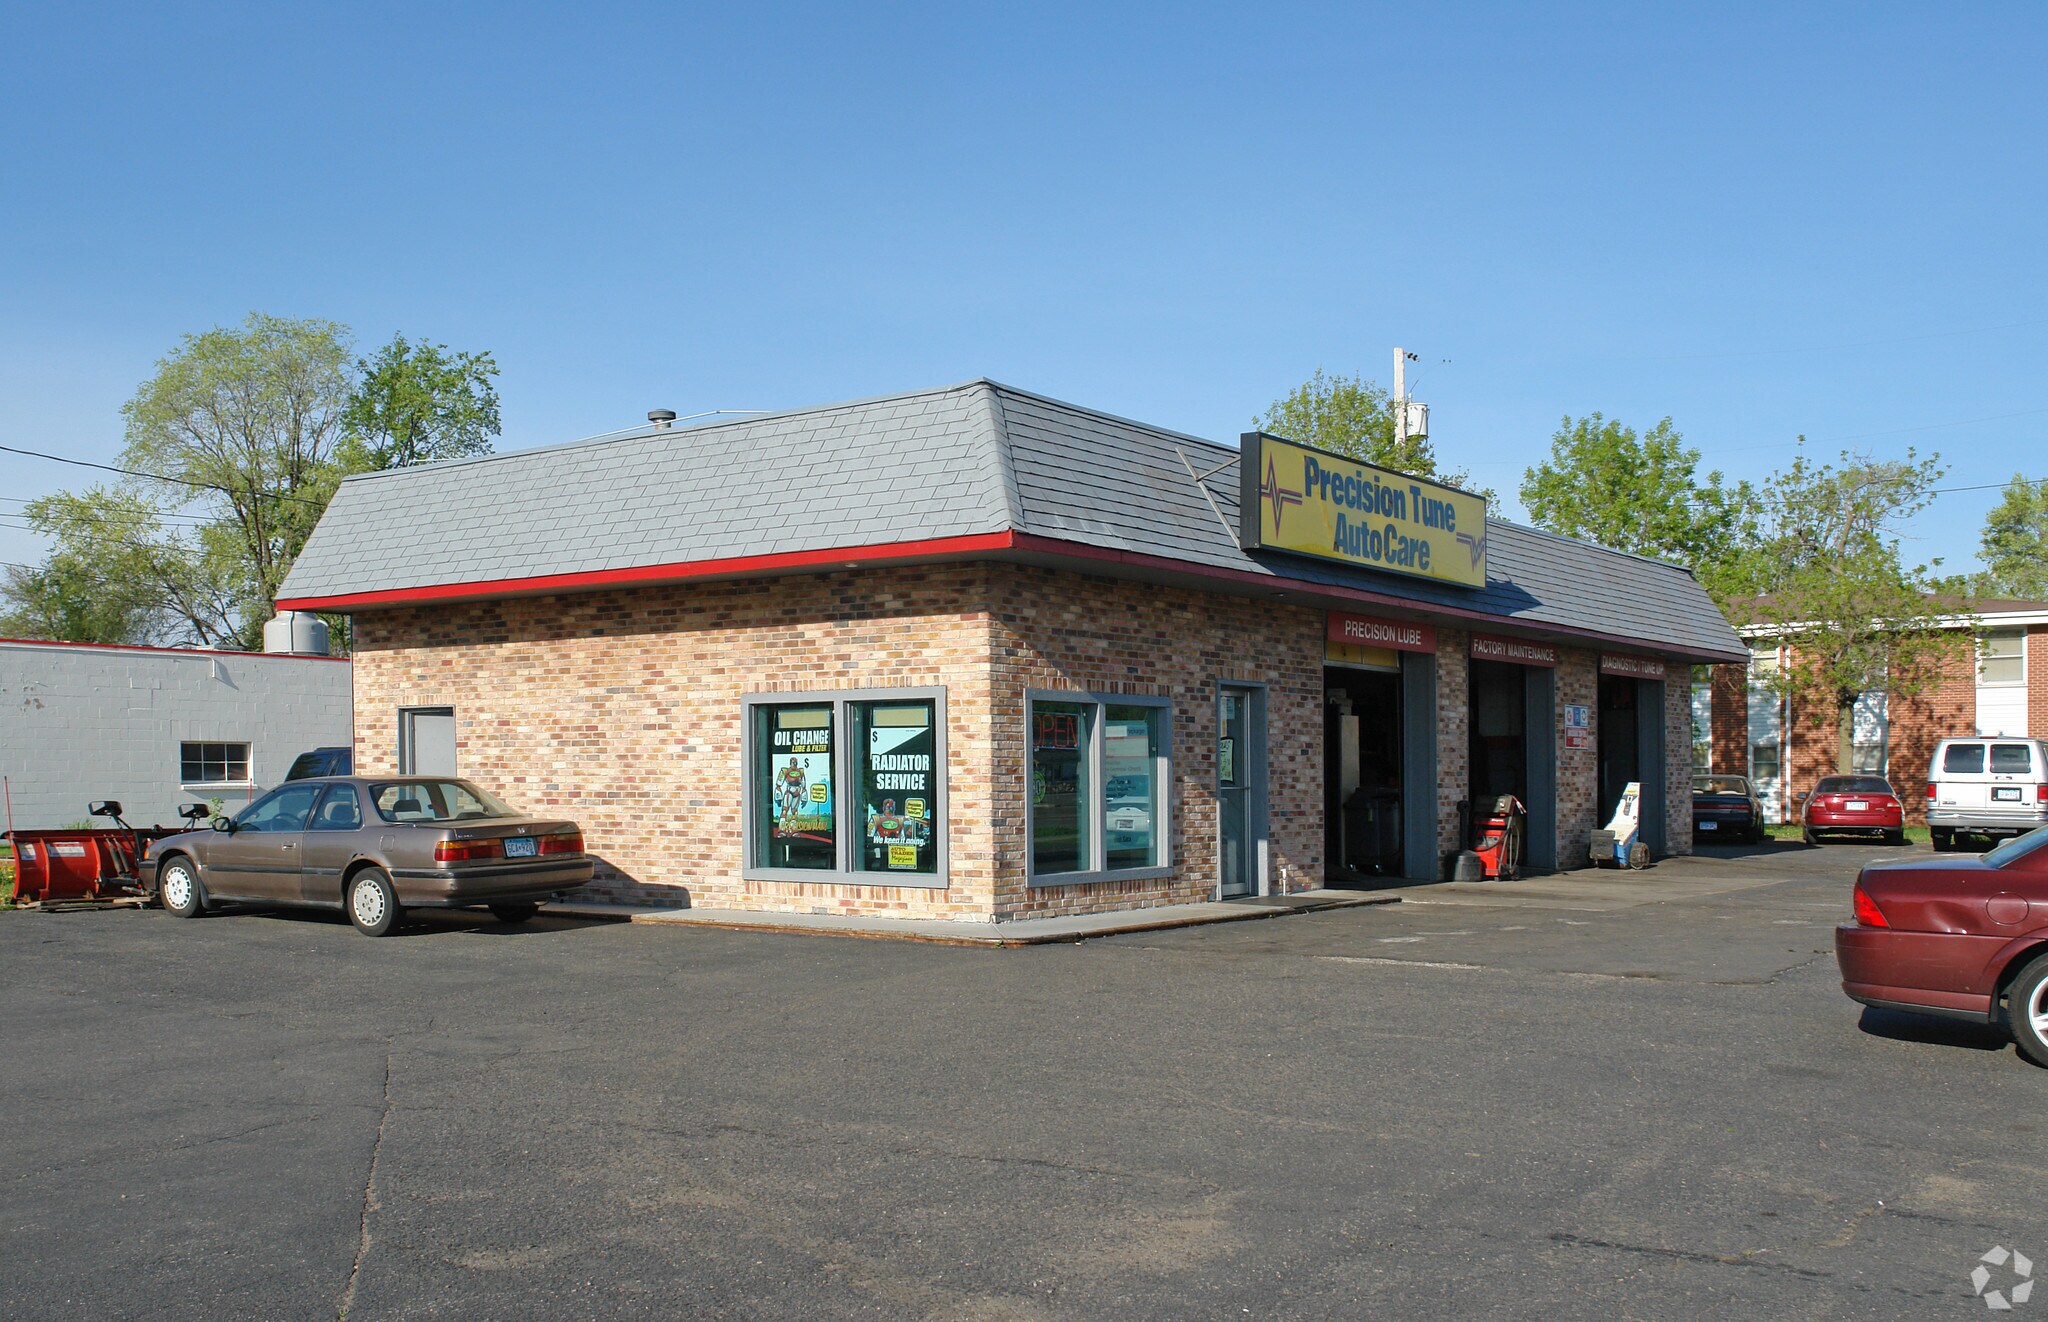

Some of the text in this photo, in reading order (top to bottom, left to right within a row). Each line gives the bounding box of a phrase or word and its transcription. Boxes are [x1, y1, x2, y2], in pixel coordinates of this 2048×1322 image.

[1304, 455, 1456, 532] Precision Tune
[1333, 512, 1430, 571] AutoCare
[1345, 620, 1422, 645] PRECISION LUBE
[1473, 639, 1555, 661] FACTORY MAINTENANCE
[1602, 655, 1637, 672] DIAGNOSTIC
[1641, 661, 1656, 675] TUNE
[1656, 664, 1665, 675] UP
[774, 729, 829, 746] OIL CHANGE
[871, 730, 878, 743] $
[804, 757, 810, 769] $
[872, 754, 930, 771] RADIATOR
[876, 773, 925, 790] SERVICE
[873, 836, 883, 844] We
[900, 836, 906, 844] it
